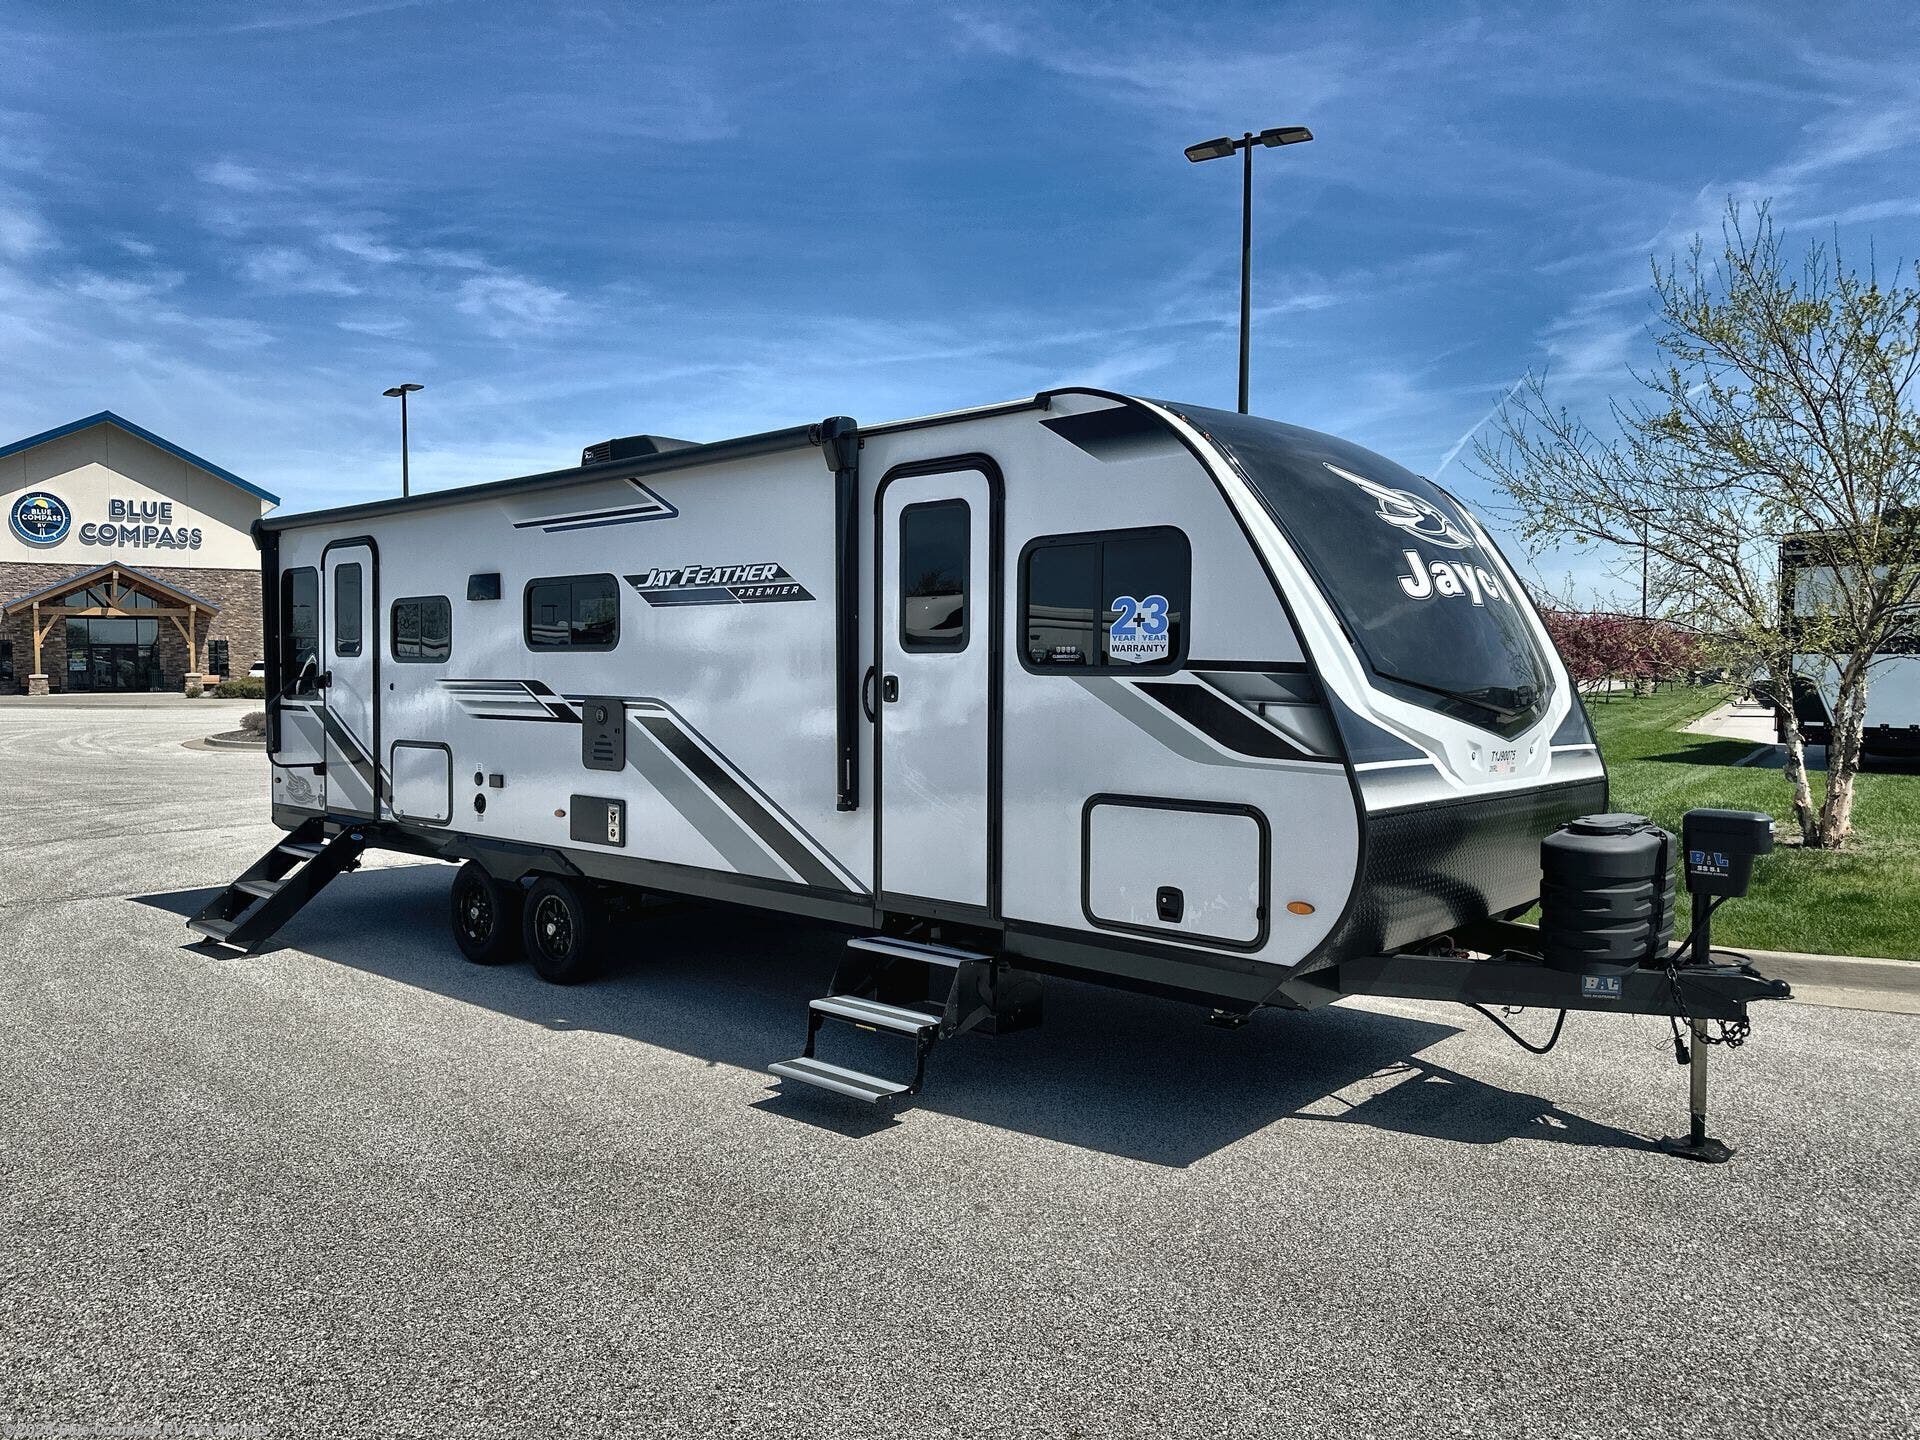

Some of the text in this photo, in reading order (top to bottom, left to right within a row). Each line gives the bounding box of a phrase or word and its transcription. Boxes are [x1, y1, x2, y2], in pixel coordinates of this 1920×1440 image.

[110, 499, 172, 519] BLUE
[80, 522, 203, 545] COMPASS
[637, 563, 779, 587] JAY FEATHER
[737, 586, 800, 597] PREMIER
[1111, 644, 1167, 652] WARRANTY
[1585, 976, 1619, 990] BAL
